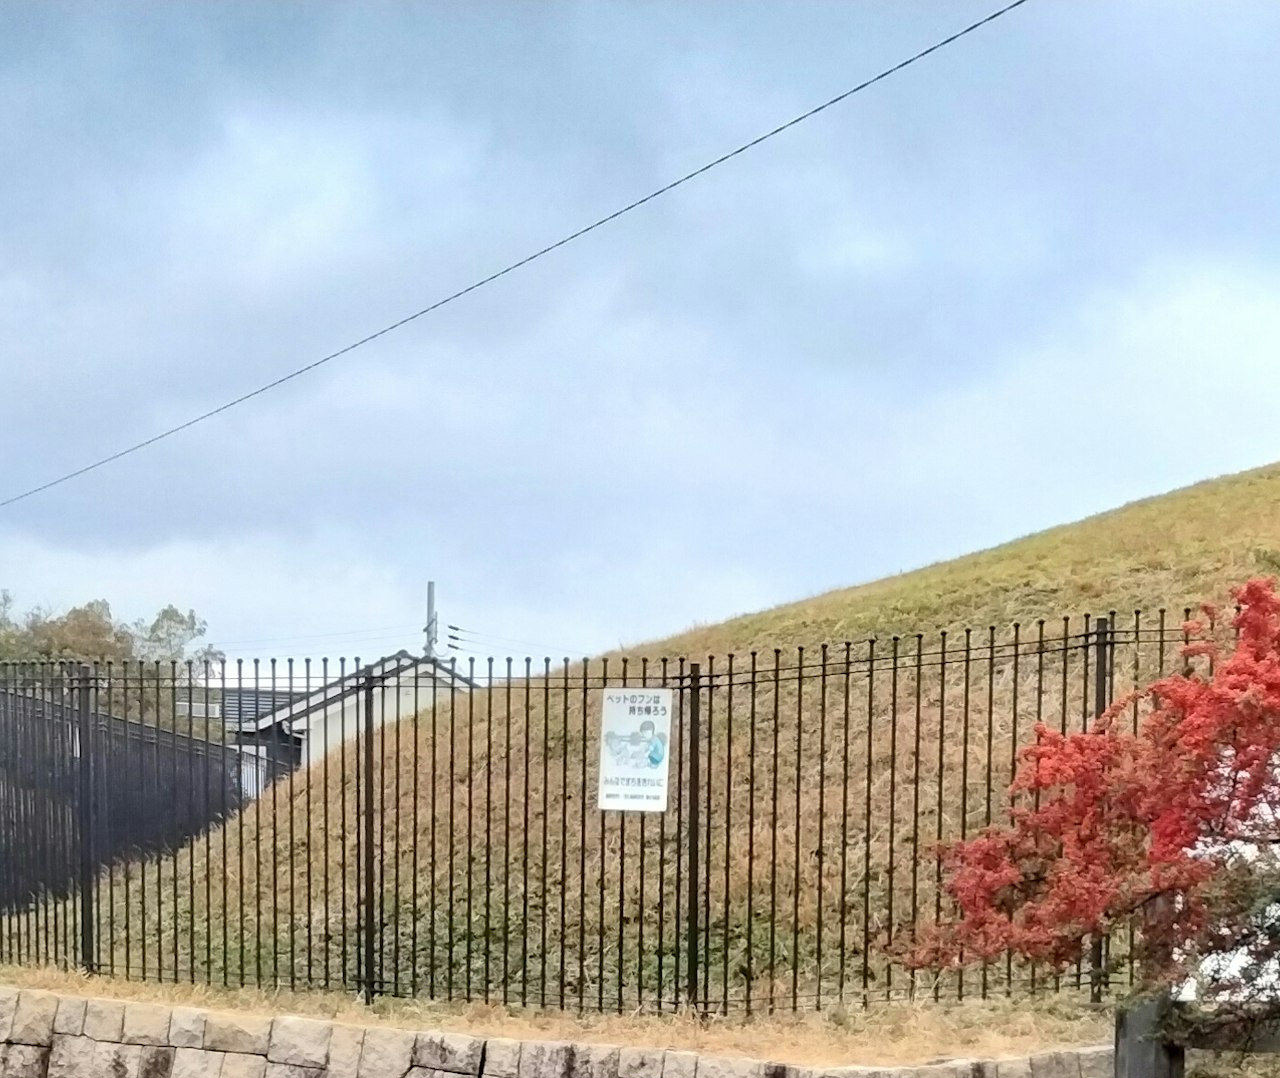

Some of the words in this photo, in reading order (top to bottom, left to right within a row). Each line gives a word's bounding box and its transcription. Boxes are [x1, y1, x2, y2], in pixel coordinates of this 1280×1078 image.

[628, 705, 667, 716] 持ち帰ろう
